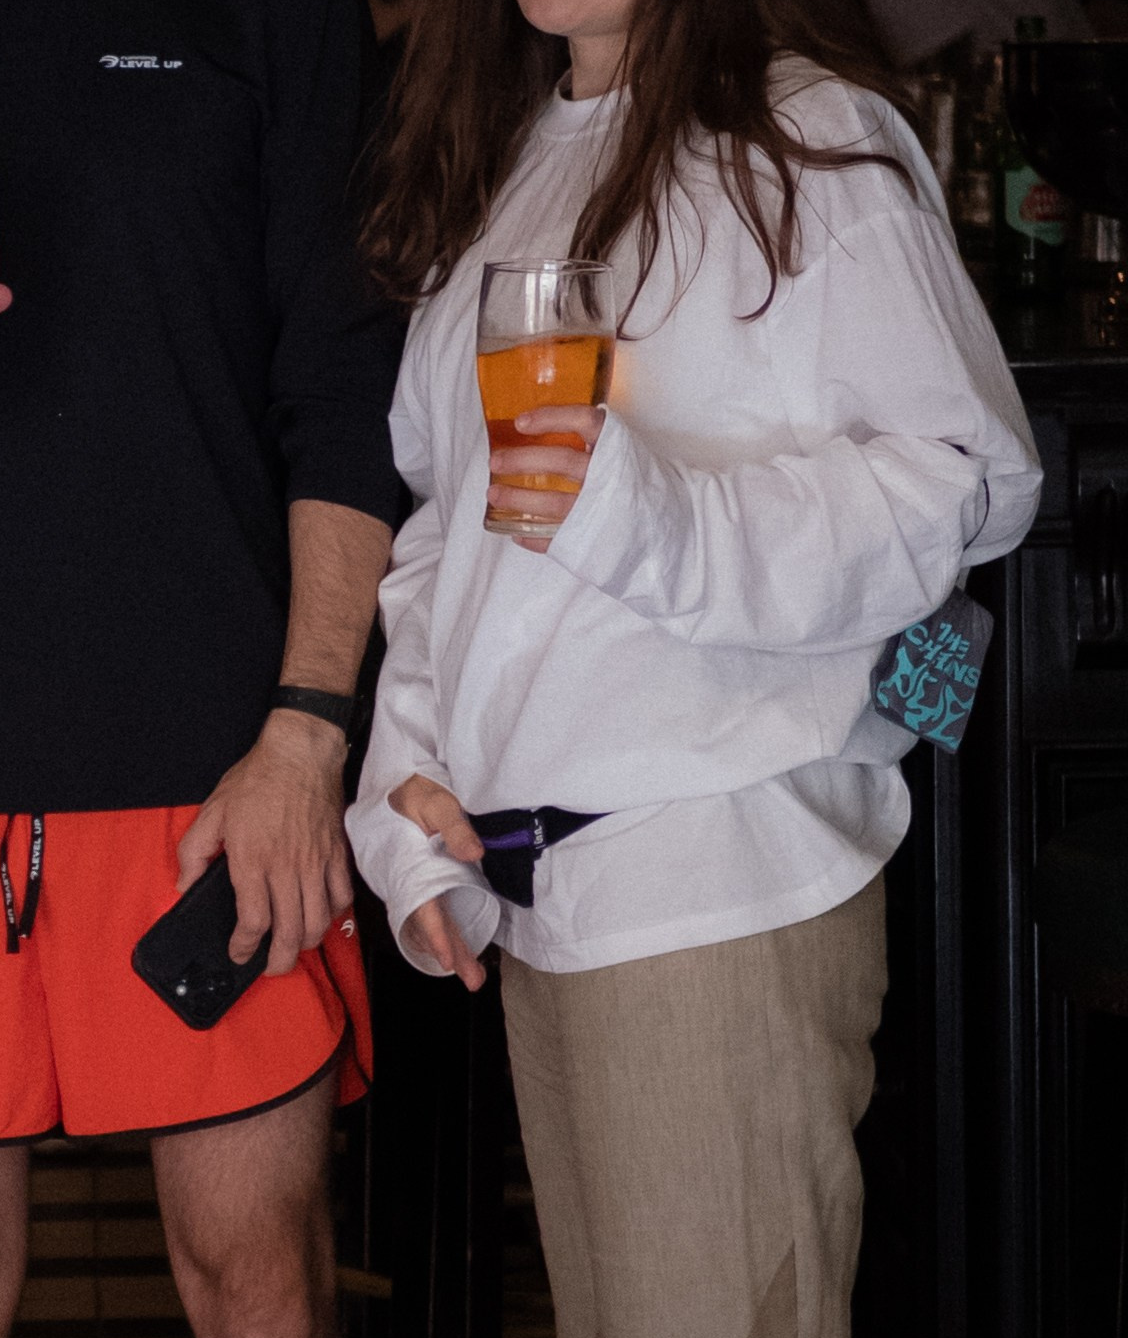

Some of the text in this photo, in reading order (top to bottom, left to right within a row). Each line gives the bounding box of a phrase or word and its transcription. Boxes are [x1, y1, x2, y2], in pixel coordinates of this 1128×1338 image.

[119, 60, 183, 69] LEVEL UP
[936, 621, 971, 659] THE
[31, 818, 42, 871] LEVEL UP
[1, 872, 15, 924] LEVEL UP
